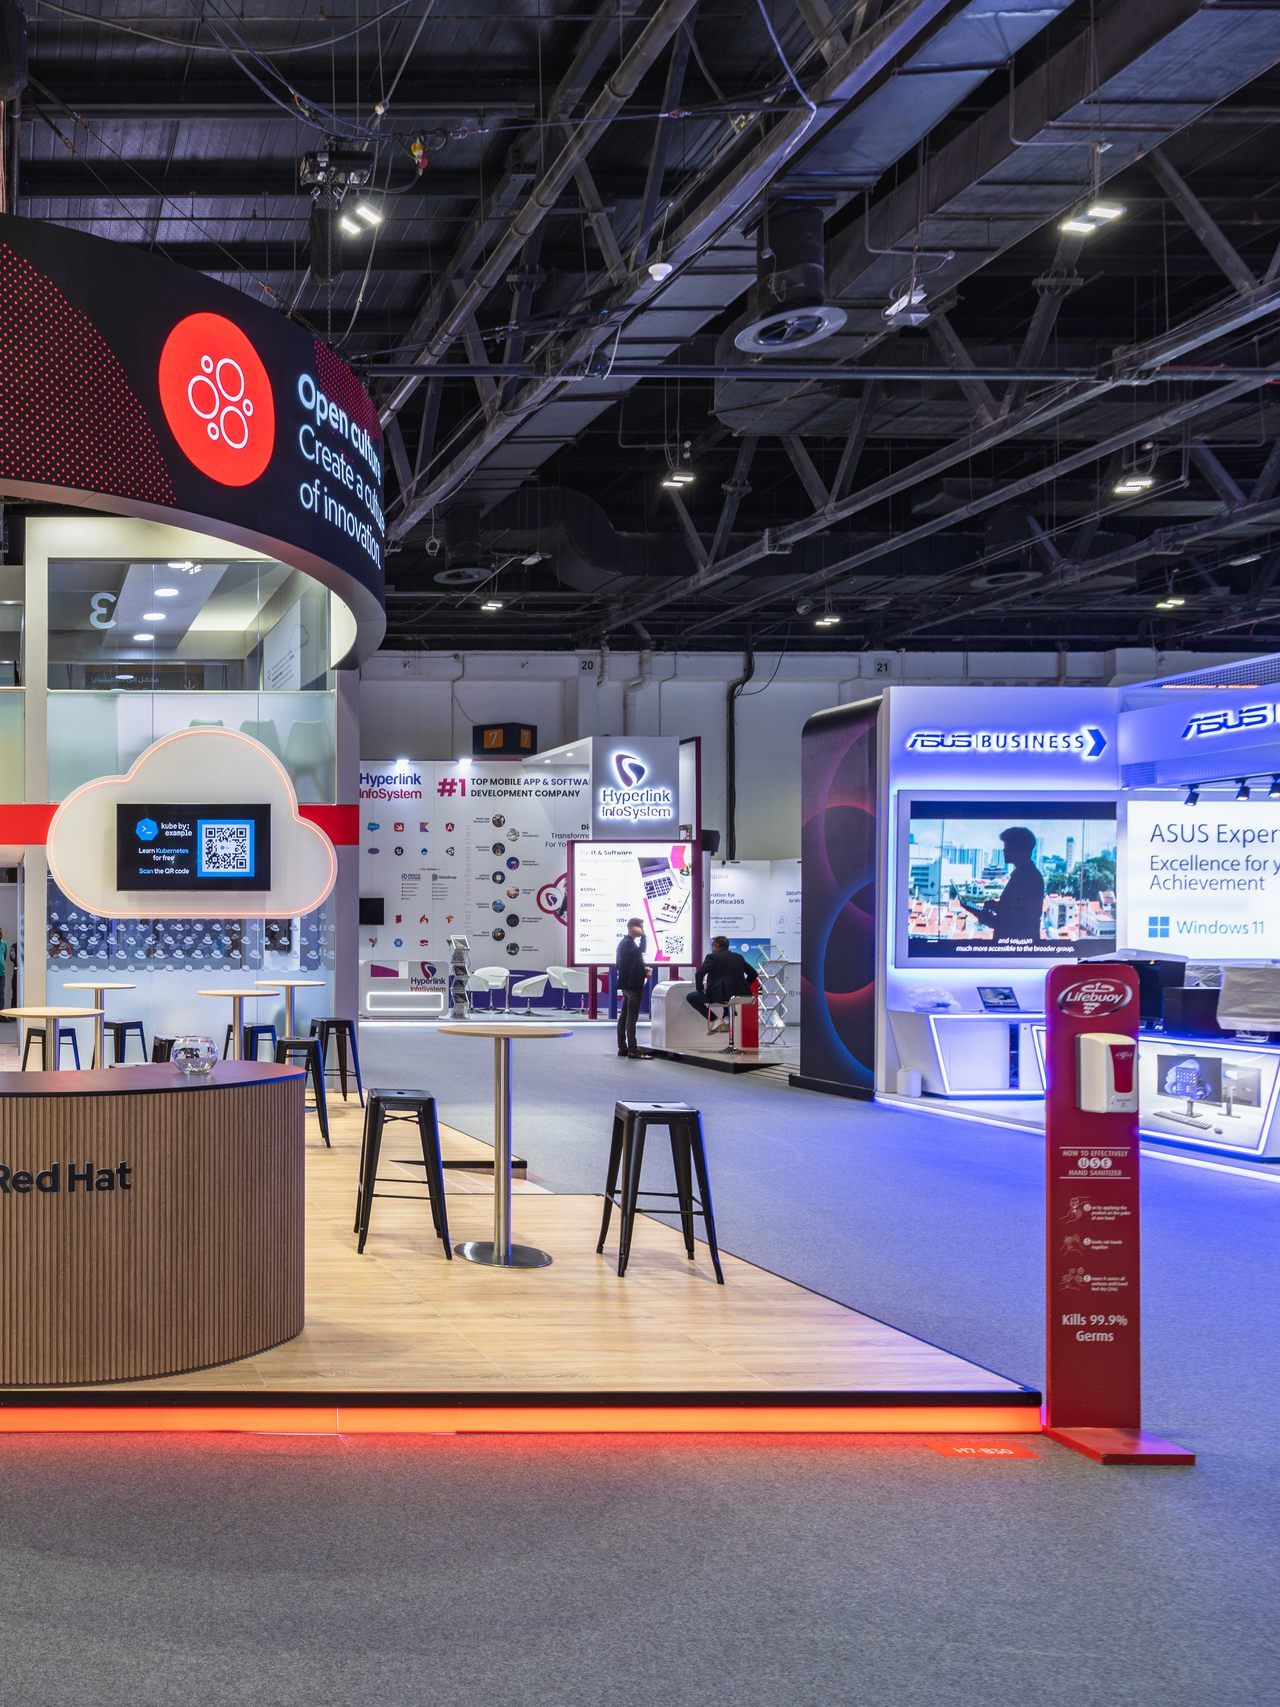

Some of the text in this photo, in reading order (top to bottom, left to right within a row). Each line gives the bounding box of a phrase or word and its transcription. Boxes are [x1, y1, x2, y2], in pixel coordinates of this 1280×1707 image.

[297, 373, 381, 485] Open culture
[299, 424, 385, 537] Create a culture
[300, 478, 381, 570] of innovation.
[581, 660, 594, 671] 20
[876, 662, 889, 673] 21
[1181, 704, 1268, 739] ASUS
[908, 733, 1084, 749] ASUS BUSINESS
[360, 772, 422, 788] Hyperlink
[436, 778, 466, 797] #1
[470, 778, 489, 786] TOP
[490, 778, 522, 786] MOBILE
[523, 778, 541, 786] APP
[551, 778, 589, 786] SOFTWA
[360, 788, 422, 802] InfoSystem
[602, 790, 670, 804] Hyperlink
[602, 806, 671, 819] InfoSystem
[165, 830, 193, 838] example
[1150, 824, 1209, 843] ASUS
[1150, 854, 1240, 872] Excellence
[1245, 854, 1268, 872] for
[1150, 874, 1265, 891] Achievement
[1177, 920, 1264, 935] Windows 11
[411, 977, 446, 986] Hyperlink
[1066, 992, 1123, 1004] Lifebuoy
[68, 1161, 132, 1192] Hat
[1062, 1314, 1128, 1326] Kills 99.9%
[1076, 1330, 1114, 1342] Germs
